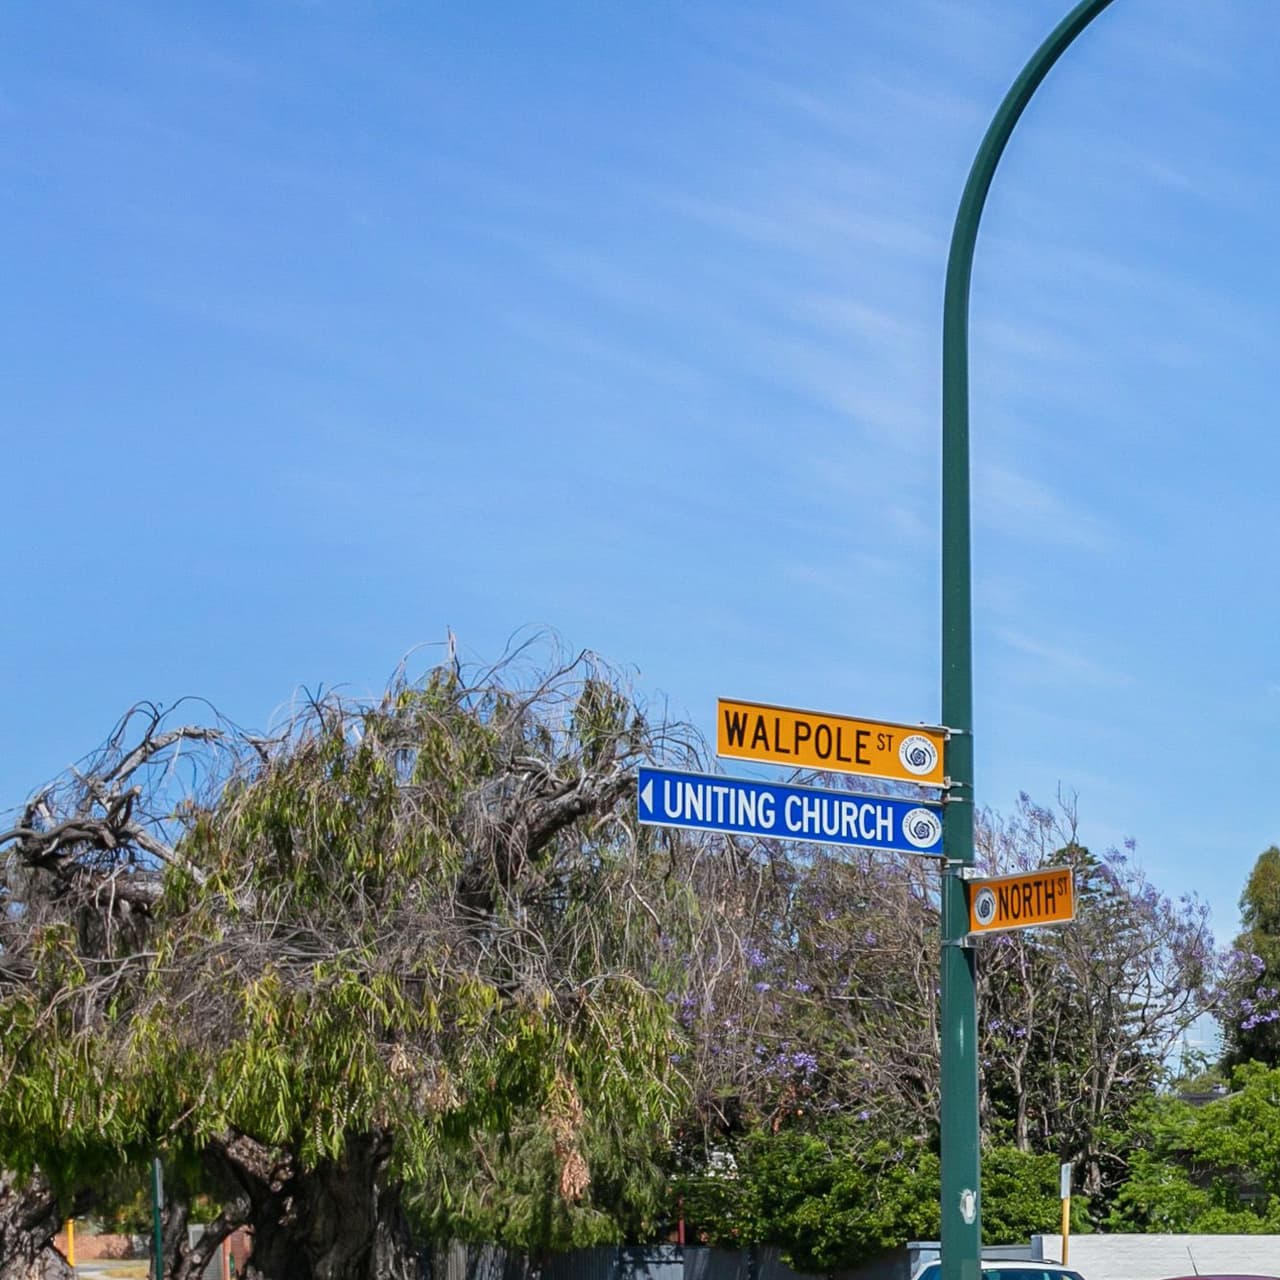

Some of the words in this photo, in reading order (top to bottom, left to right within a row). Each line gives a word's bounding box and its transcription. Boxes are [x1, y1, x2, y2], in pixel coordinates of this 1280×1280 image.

[725, 710, 871, 765] WALPOLE
[876, 733, 894, 753] ST
[664, 780, 775, 829] UNITING
[784, 795, 893, 842] CHURCH
[998, 879, 1056, 921] NORTH
[1057, 877, 1067, 896] ST
